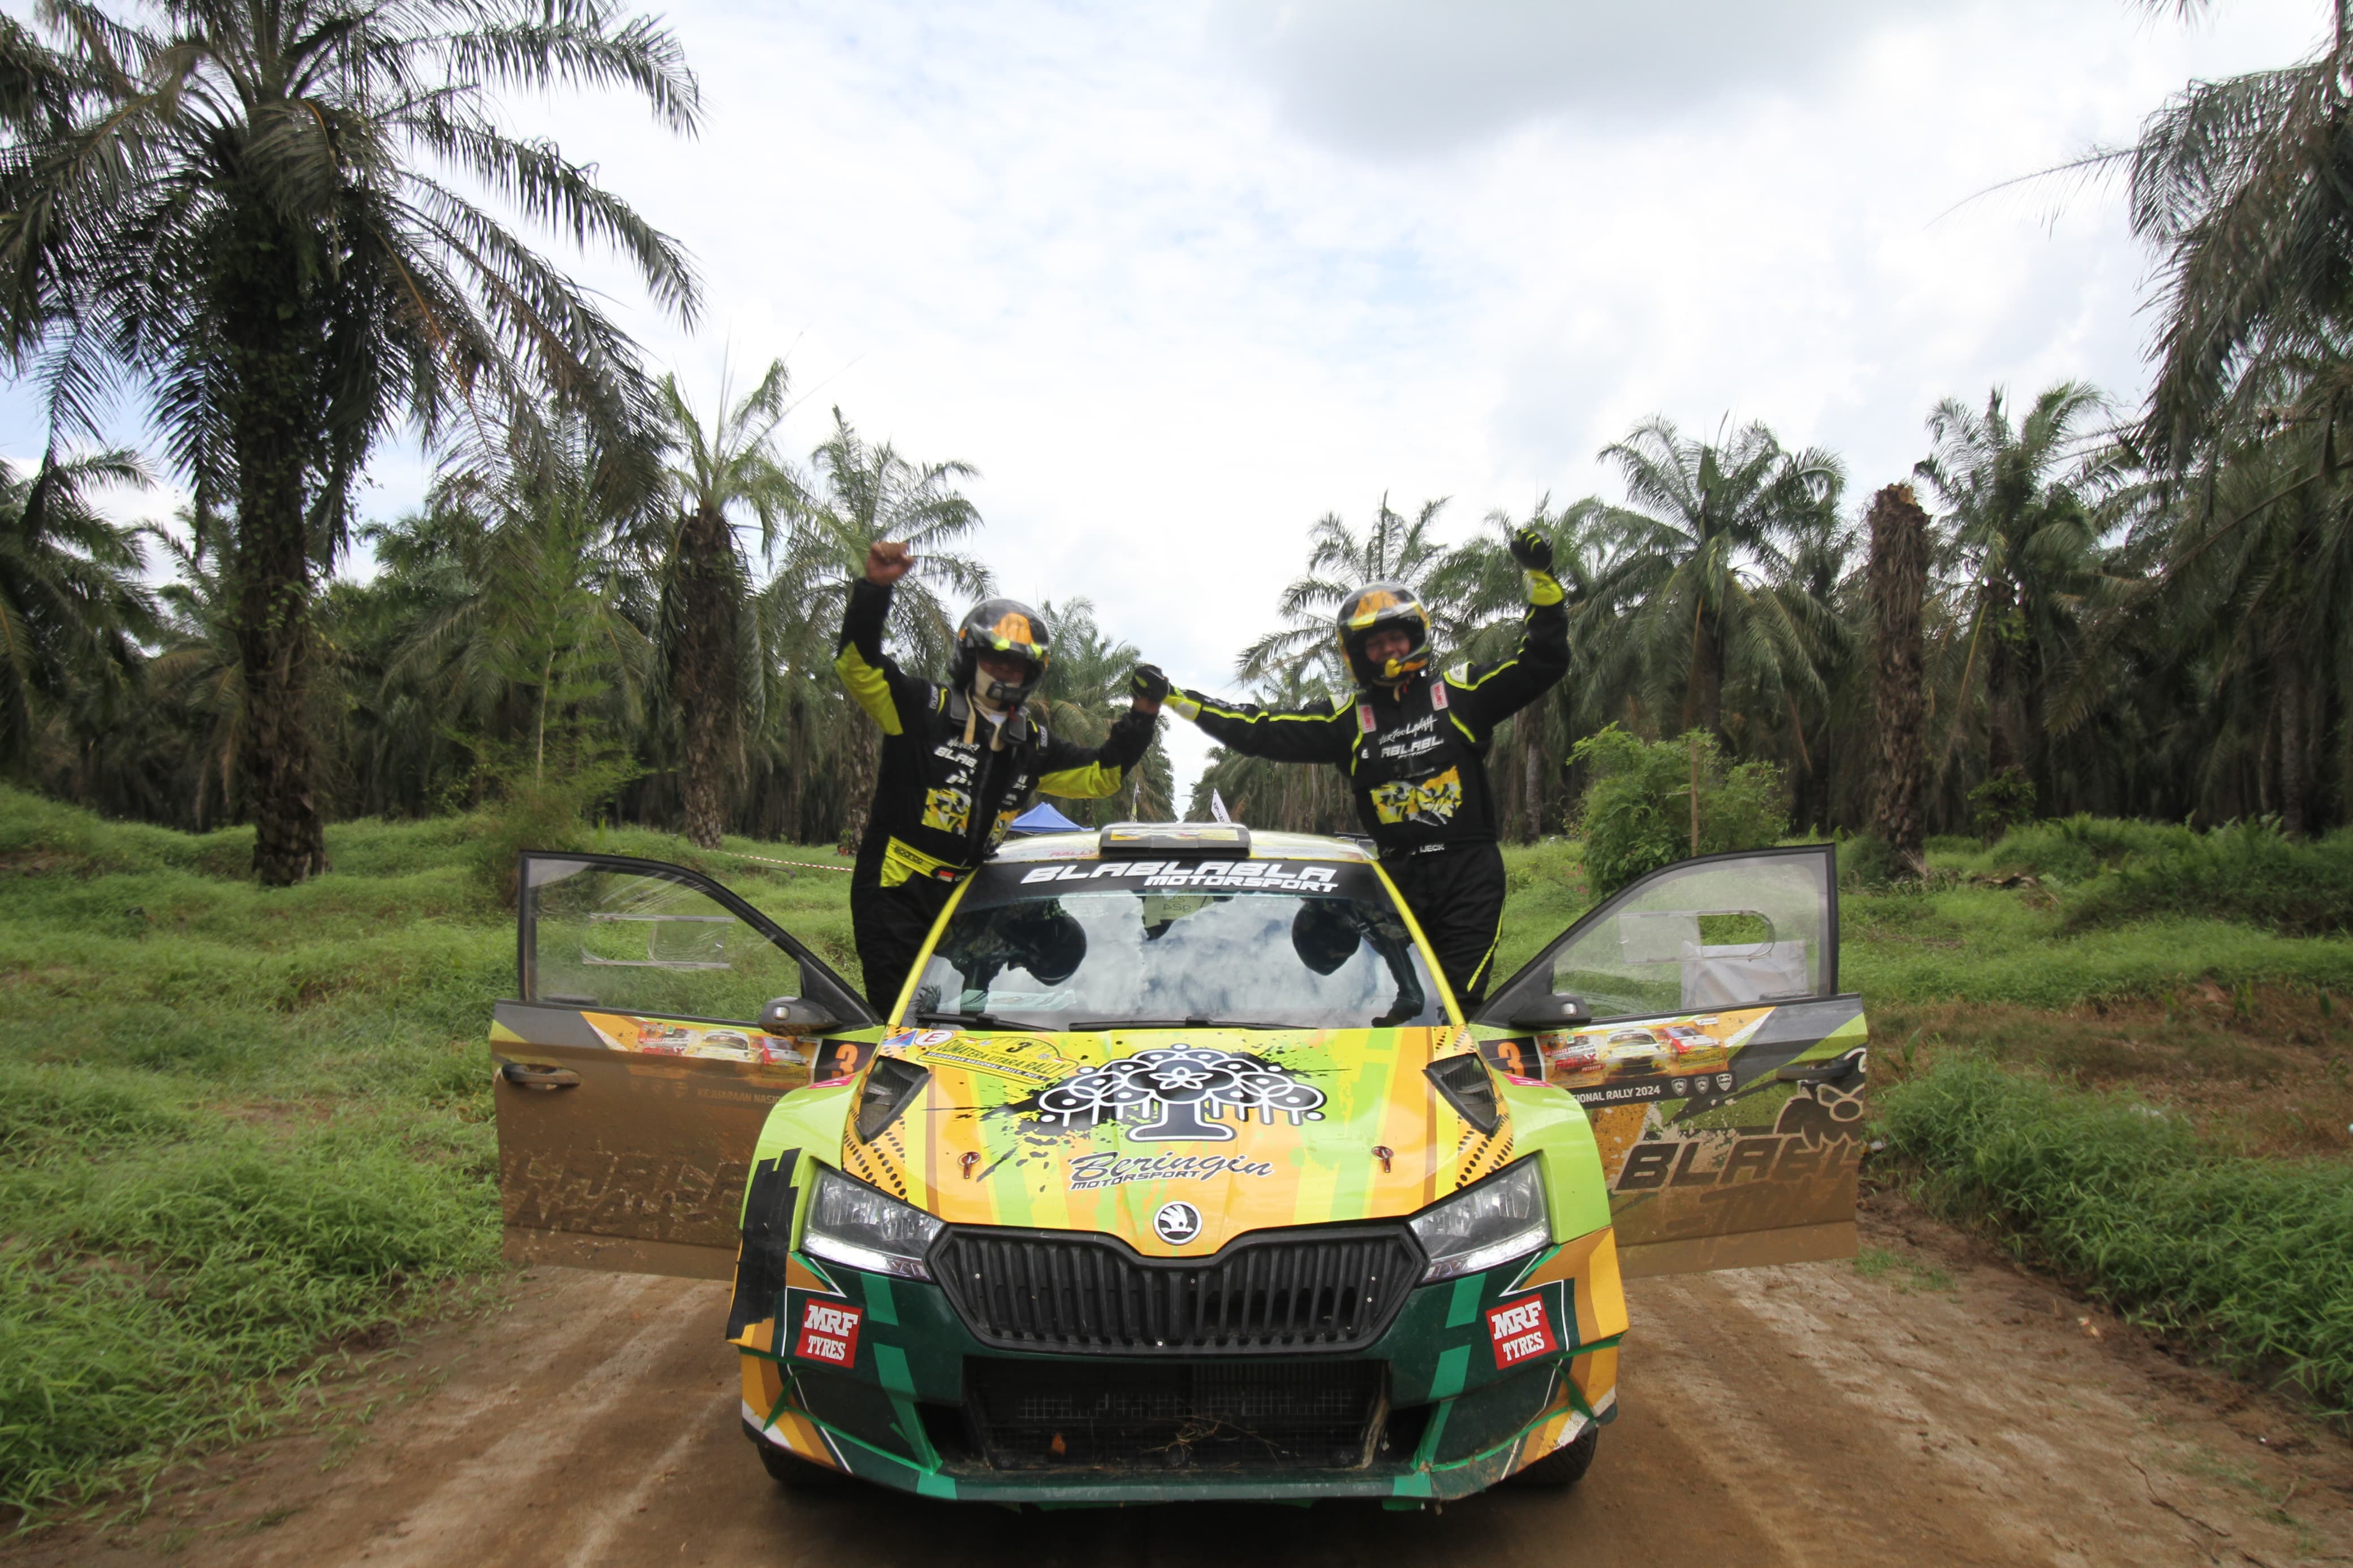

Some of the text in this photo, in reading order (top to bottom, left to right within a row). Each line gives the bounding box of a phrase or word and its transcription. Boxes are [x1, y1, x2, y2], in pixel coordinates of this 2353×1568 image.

[934, 745, 978, 768] BLAB
[1020, 861, 1338, 884] BLABLABLA
[1144, 875, 1338, 893] MOTORSPORT
[923, 1033, 945, 1043] E
[1006, 1042, 1032, 1053] 3
[831, 1044, 859, 1079] 3
[936, 1039, 989, 1060] SUMATERA
[987, 1056, 1026, 1068] UTARA
[1023, 1061, 1072, 1075] RALLY
[1498, 1042, 1525, 1077] 3
[1606, 1087, 1634, 1100] RALLY
[1635, 1085, 1661, 1097] 2024
[1070, 1151, 1274, 1181] Beringin
[1070, 1170, 1202, 1190] MOTORSPORT
[804, 1304, 859, 1337] MRF
[1491, 1301, 1542, 1340] MRF
[807, 1335, 846, 1361] TYRES
[1502, 1331, 1545, 1362] TYRES
